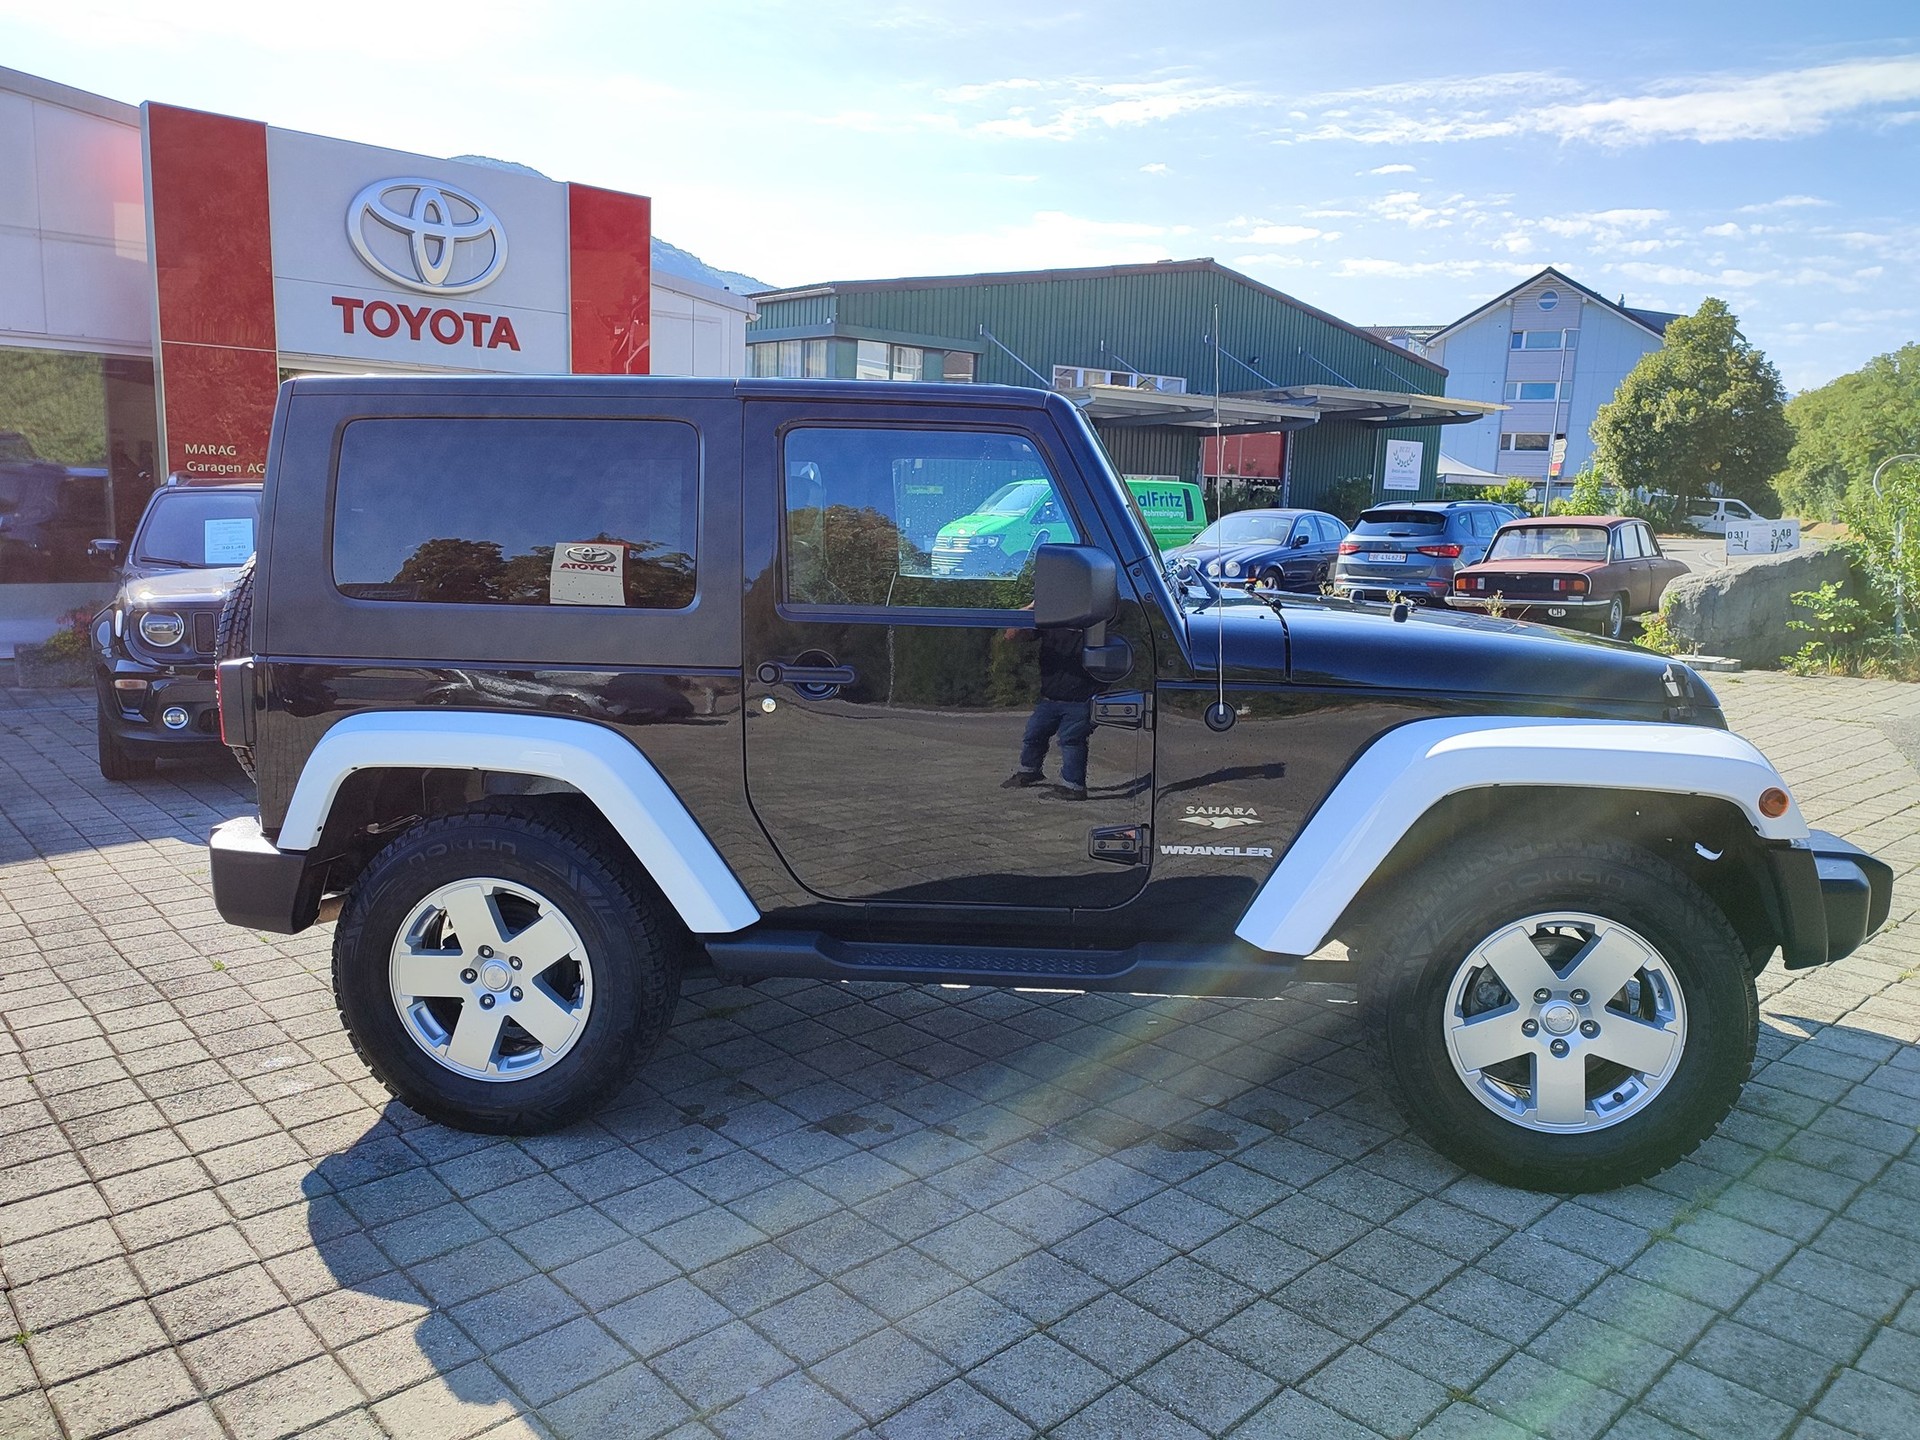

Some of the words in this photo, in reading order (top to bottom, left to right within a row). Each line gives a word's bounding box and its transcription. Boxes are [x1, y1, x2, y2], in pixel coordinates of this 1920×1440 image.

[331, 296, 521, 352] TOYOTA
[184, 443, 237, 456] MARAG
[186, 461, 242, 475] Garagen
[247, 463, 266, 474] AG
[1133, 491, 1183, 507] alFritz
[1551, 607, 1563, 616] CH
[1185, 805, 1258, 816] SAHARA
[1159, 845, 1274, 858] WRANGLER
